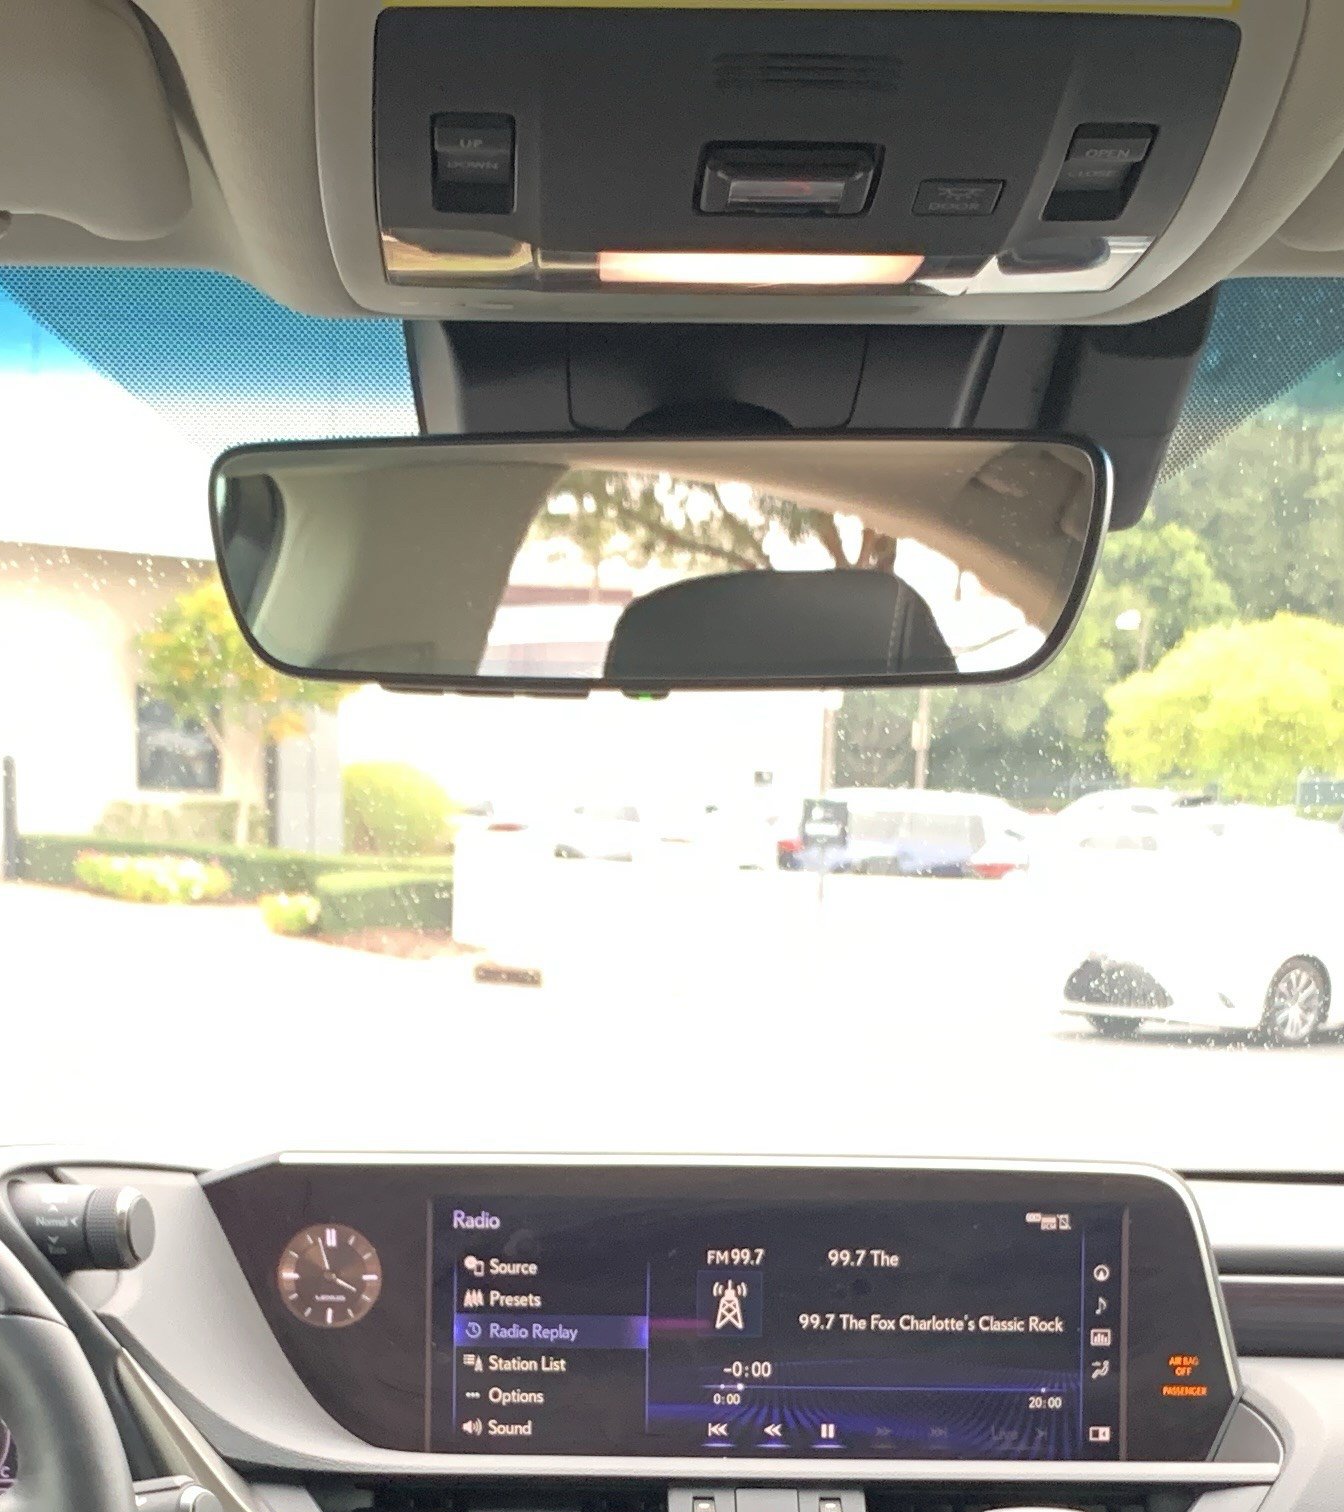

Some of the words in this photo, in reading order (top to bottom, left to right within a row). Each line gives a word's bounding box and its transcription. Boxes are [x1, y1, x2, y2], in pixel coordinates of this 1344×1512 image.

[459, 138, 483, 148] UP
[1084, 148, 1131, 159] OPEN
[35, 1216, 69, 1227] Normal
[452, 1210, 502, 1230] Radio
[827, 1248, 867, 1267] 99.7
[869, 1249, 900, 1268] The
[488, 1259, 538, 1276] Source
[488, 1290, 542, 1308] Presets
[798, 1313, 836, 1330] 99.7
[839, 1314, 867, 1331] The
[869, 1315, 896, 1331] Fox
[898, 1313, 976, 1332] Charlotte's
[977, 1314, 1026, 1333] Classic
[1028, 1316, 1065, 1333] Rock
[488, 1324, 530, 1340] Radio
[531, 1324, 579, 1344] Replay
[487, 1355, 540, 1372] Station
[540, 1356, 567, 1373] List
[722, 1360, 773, 1378] -0:00
[1174, 1365, 1193, 1376] OFF
[487, 1386, 545, 1407] Options
[712, 1393, 742, 1406] 0:00
[1161, 1386, 1208, 1397] PASSENGER
[1028, 1396, 1064, 1410] 20:00
[487, 1419, 533, 1436] Sound
